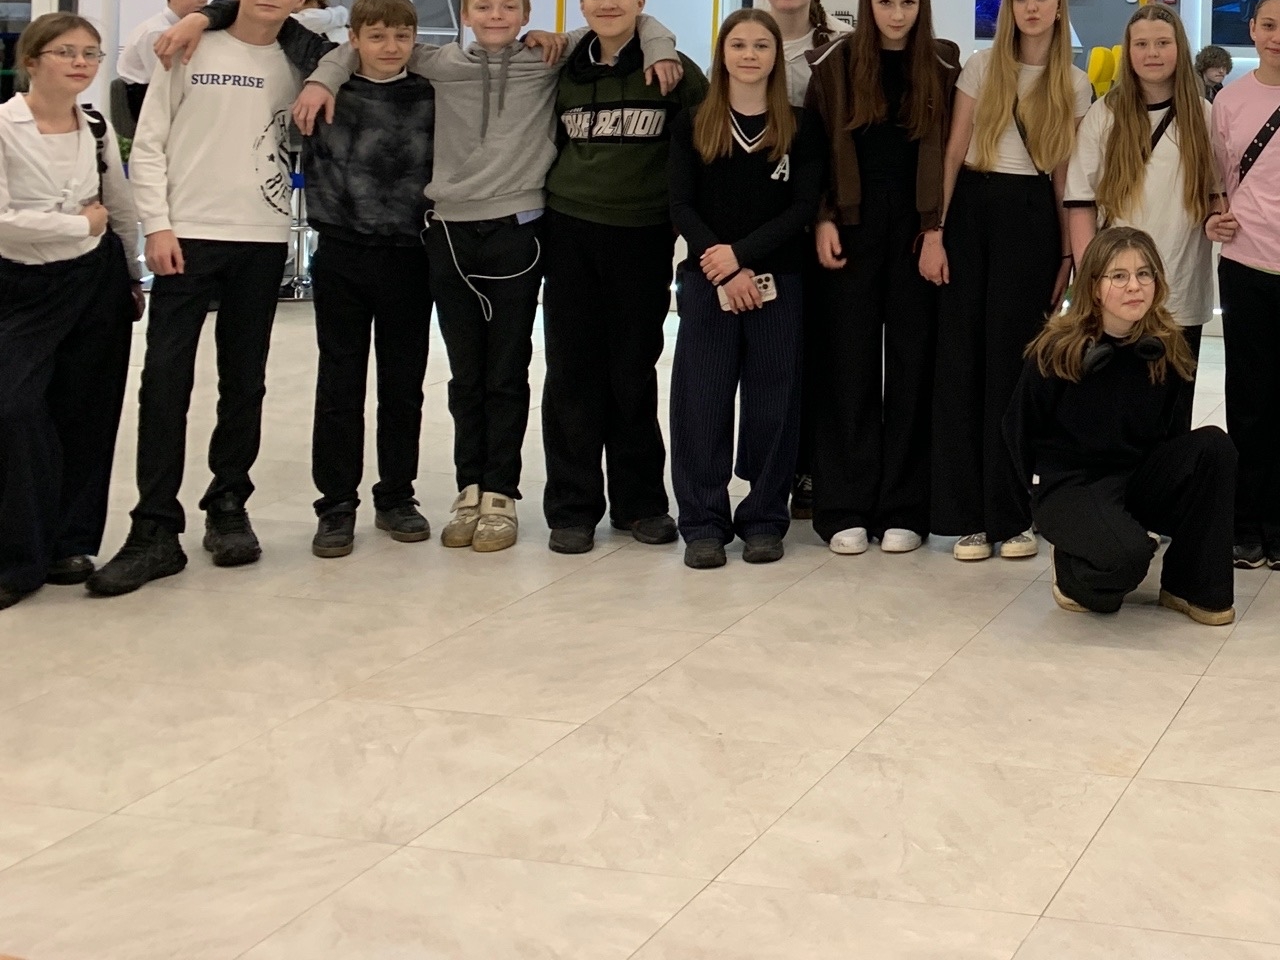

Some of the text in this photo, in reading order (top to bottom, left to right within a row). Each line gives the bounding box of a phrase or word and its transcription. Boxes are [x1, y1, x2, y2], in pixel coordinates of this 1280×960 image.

[191, 73, 264, 88] SURPRISE
[592, 108, 667, 137] ACTION
[770, 153, 790, 182] A
